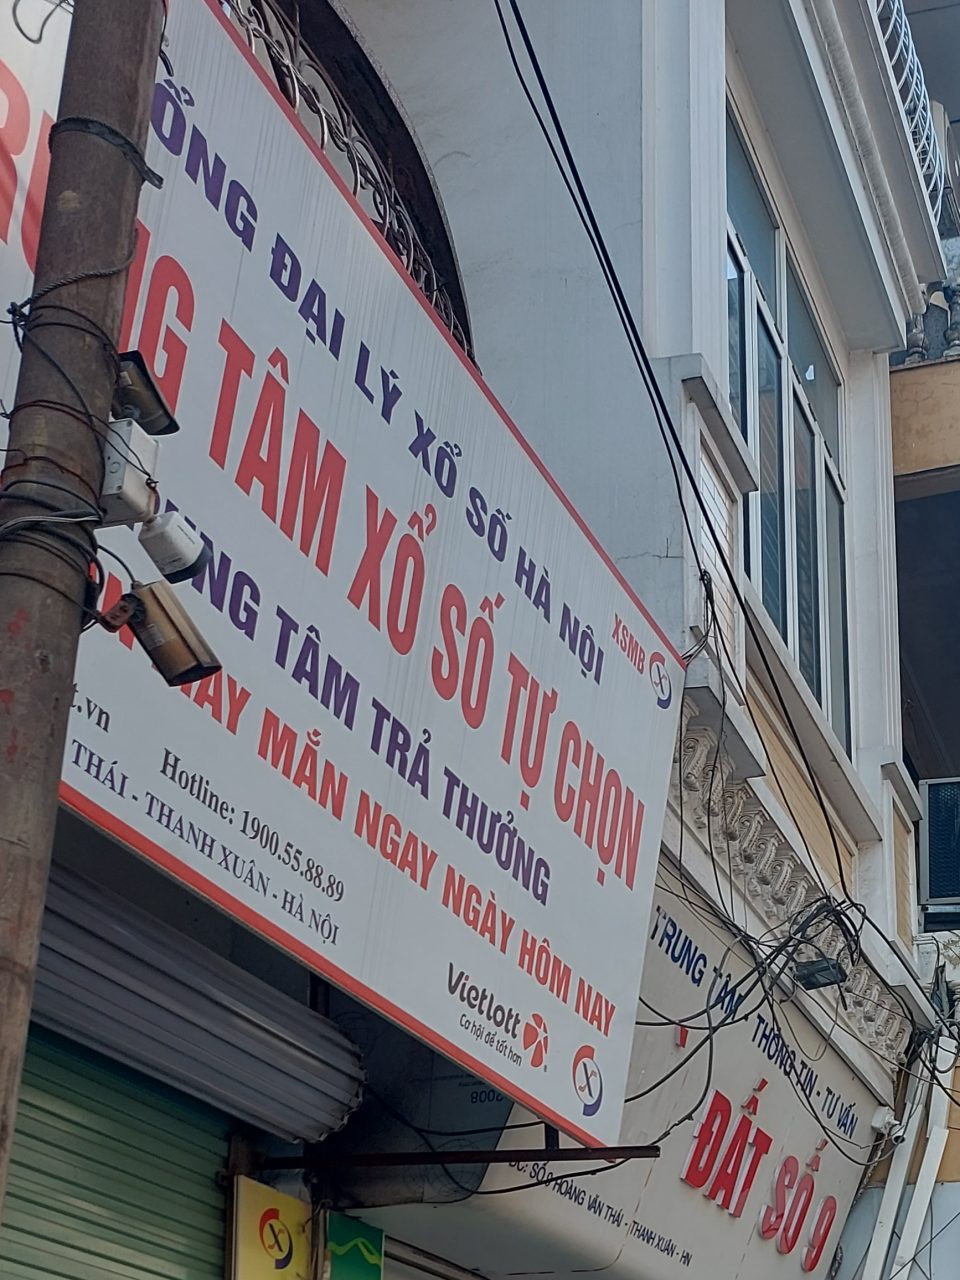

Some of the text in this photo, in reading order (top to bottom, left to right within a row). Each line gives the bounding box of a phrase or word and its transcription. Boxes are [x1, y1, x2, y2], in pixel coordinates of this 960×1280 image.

[150, 78, 604, 686] ỔNG ĐẠI LÝ XỔ SỐ HÀ NỘI
[208, 318, 347, 577] TÂM
[347, 484, 437, 656] XỔ
[431, 583, 506, 731] SỐ
[501, 652, 558, 811] TỰ
[554, 721, 645, 892] CHỌN
[611, 613, 646, 675] XSMB
[71, 738, 129, 799] THÁI
[145, 792, 217, 861] THANH
[217, 843, 271, 898] XUÂN
[281, 888, 305, 923] HÀ
[308, 909, 340, 946] NỘI
[160, 748, 345, 903] Hotline: 1900.55.88.89
[275, 604, 360, 731] TÂM
[370, 697, 432, 800] TRẢ
[441, 766, 550, 906] THƯỞNG
[257, 707, 348, 821] MẮN
[354, 789, 439, 891] NGAY
[441, 864, 516, 955] NGÀY
[518, 929, 573, 1005] HÔM
[574, 976, 616, 1037] NAY
[447, 961, 521, 1039] Vietlott
[459, 1013, 471, 1029] Cơ
[470, 1019, 485, 1041] hội
[507, 1049, 522, 1067] hơn
[649, 904, 708, 987] TRUNG
[751, 1013, 796, 1078] THÔNG
[796, 1060, 819, 1101] TIN
[837, 1102, 859, 1140] VẤN
[552, 1177, 587, 1208] HOÀNG
[587, 1193, 605, 1217] VĂN
[603, 1202, 626, 1228] THÁI
[628, 1219, 657, 1247] THANH
[652, 1233, 677, 1258] XUÂN
[678, 1248, 693, 1268] HN
[680, 1077, 838, 1273] ĐẤT SỐ 9
